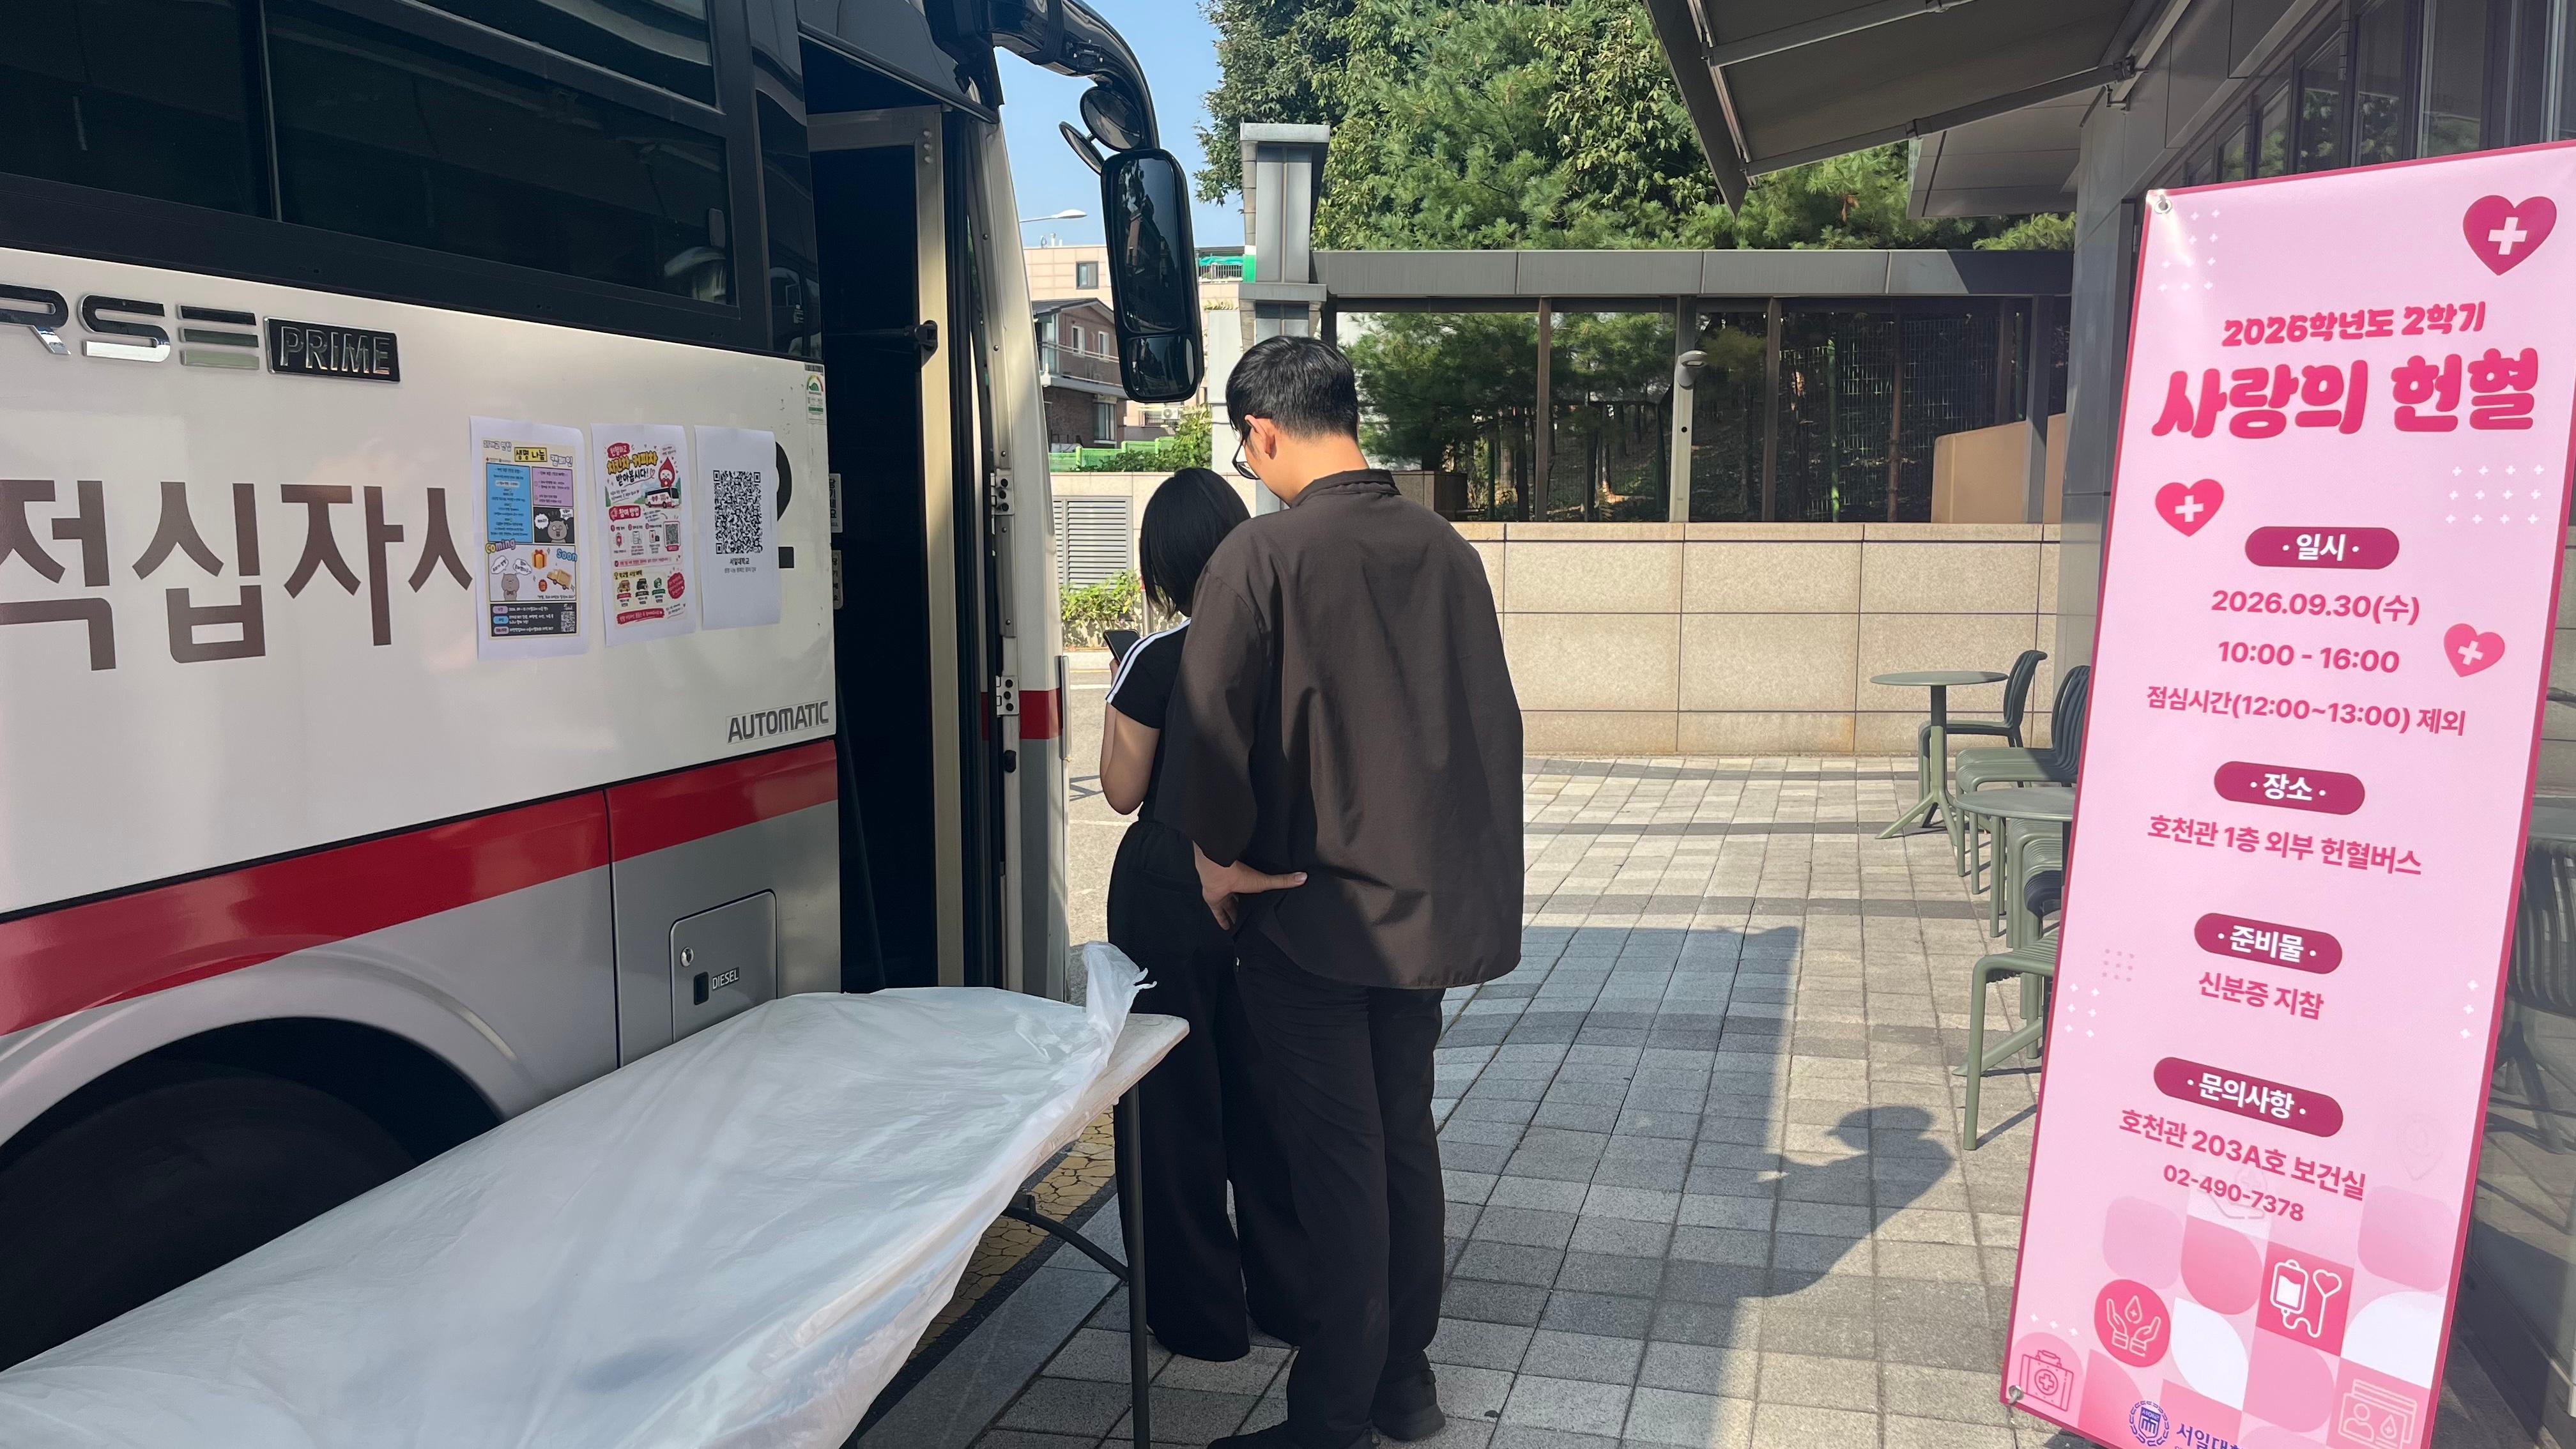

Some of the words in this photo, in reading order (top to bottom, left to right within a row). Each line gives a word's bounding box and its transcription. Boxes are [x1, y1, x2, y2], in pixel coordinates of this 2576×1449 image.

[2222, 309, 2394, 346] 2026학년도
[2402, 302, 2485, 335] 2학기
[280, 326, 390, 375] PRIME
[2152, 360, 2368, 439] 사랑의
[2391, 348, 2538, 432] 헌혈
[516, 449, 529, 460] 생명
[532, 450, 544, 461] 나눔
[2297, 534, 2345, 561] 일시
[2212, 590, 2419, 625] 2026.09.30(수)
[2220, 641, 2294, 666] 10:00
[2320, 648, 2399, 673] 16:00
[728, 701, 829, 743] AUTOMATIC
[2147, 686, 2410, 733] 점심시간(12:00~13:00)
[2417, 709, 2465, 736] 제외
[2264, 774, 2312, 801] 장소
[2148, 815, 2218, 847] 호천관
[2225, 827, 2259, 852] 1층
[2266, 832, 2313, 860] 외부
[2321, 838, 2421, 875] 헌혈버스
[2230, 926, 2303, 962] 준비물
[712, 969, 739, 990] DIESEL
[2199, 972, 2268, 1007] 신분증
[2274, 988, 2324, 1020] 지참
[2200, 1073, 2294, 1118] 문의사항
[2120, 1110, 2188, 1148] 호천관
[2192, 1130, 2286, 1176] 203A호
[2292, 1157, 2365, 1201] 보건실
[2164, 1165, 2303, 1221] 02-490-7378
